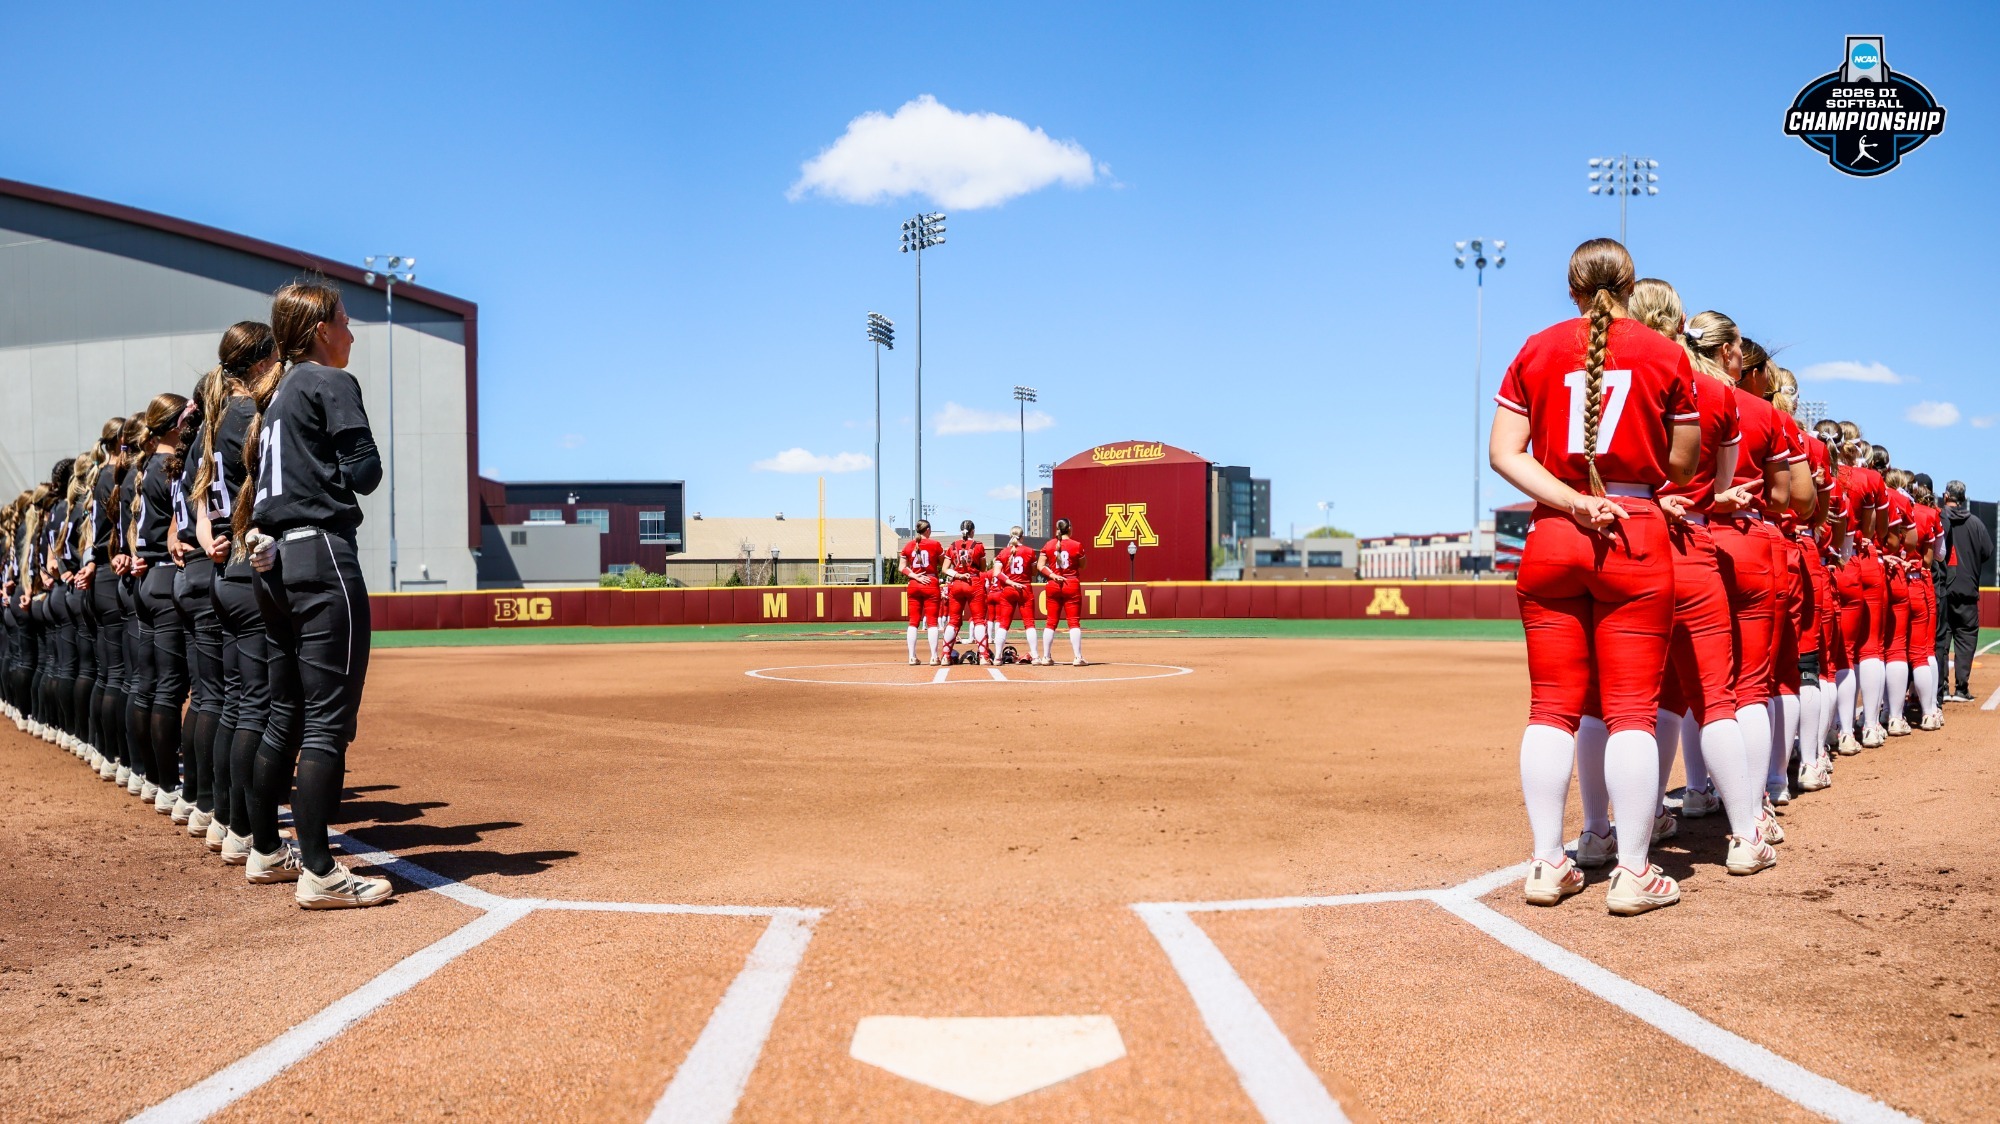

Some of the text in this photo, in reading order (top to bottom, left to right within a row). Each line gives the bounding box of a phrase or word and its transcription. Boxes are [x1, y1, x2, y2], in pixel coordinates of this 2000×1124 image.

[1564, 369, 1632, 454] 17
[253, 419, 282, 507] 21
[1092, 442, 1163, 461] Siebert Field
[1094, 503, 1159, 548] M
[911, 550, 929, 568] 20
[1366, 588, 1409, 615] M
